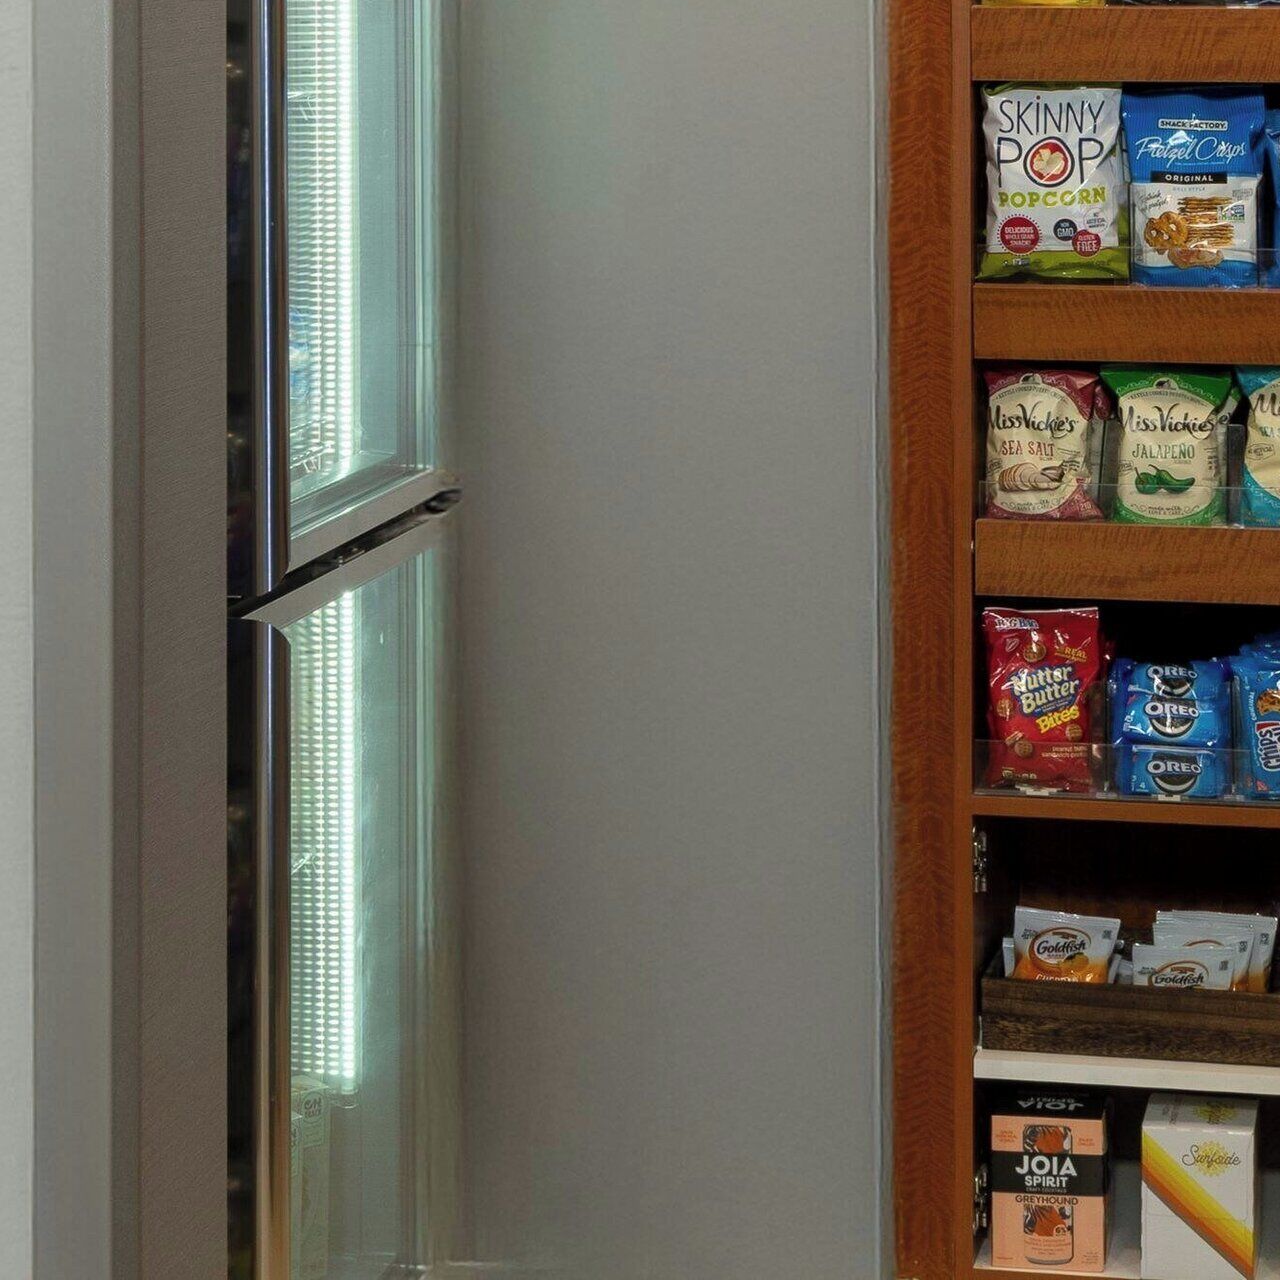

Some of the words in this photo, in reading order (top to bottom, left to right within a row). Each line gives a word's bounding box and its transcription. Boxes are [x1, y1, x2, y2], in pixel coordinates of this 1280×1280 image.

[1160, 120, 1187, 128] SNACK
[997, 136, 1104, 188] POP
[1165, 174, 1214, 183] ORIGINAL
[997, 187, 1107, 209] POPCORN
[1057, 228, 1074, 238] GMO
[1077, 241, 1098, 252] FREE
[1016, 400, 1075, 438] Vickie's
[1002, 440, 1023, 456] SEA
[1028, 440, 1056, 456] SALT
[1132, 443, 1195, 459] JALAPEÑO
[1147, 666, 1198, 679] OREO
[1010, 666, 1073, 696] Nutter
[1020, 680, 1080, 714] Butter
[1144, 701, 1200, 718] OREO
[1035, 704, 1081, 734] Bites
[1147, 760, 1202, 774] OREO
[1036, 940, 1086, 955] Goldfish
[1154, 972, 1205, 985] Goldfish
[1182, 1144, 1242, 1168] Surfside
[1015, 1155, 1078, 1177] JOIA
[1024, 1176, 1068, 1188] SPIRIT
[1015, 1195, 1079, 1206] GREYHOUND
